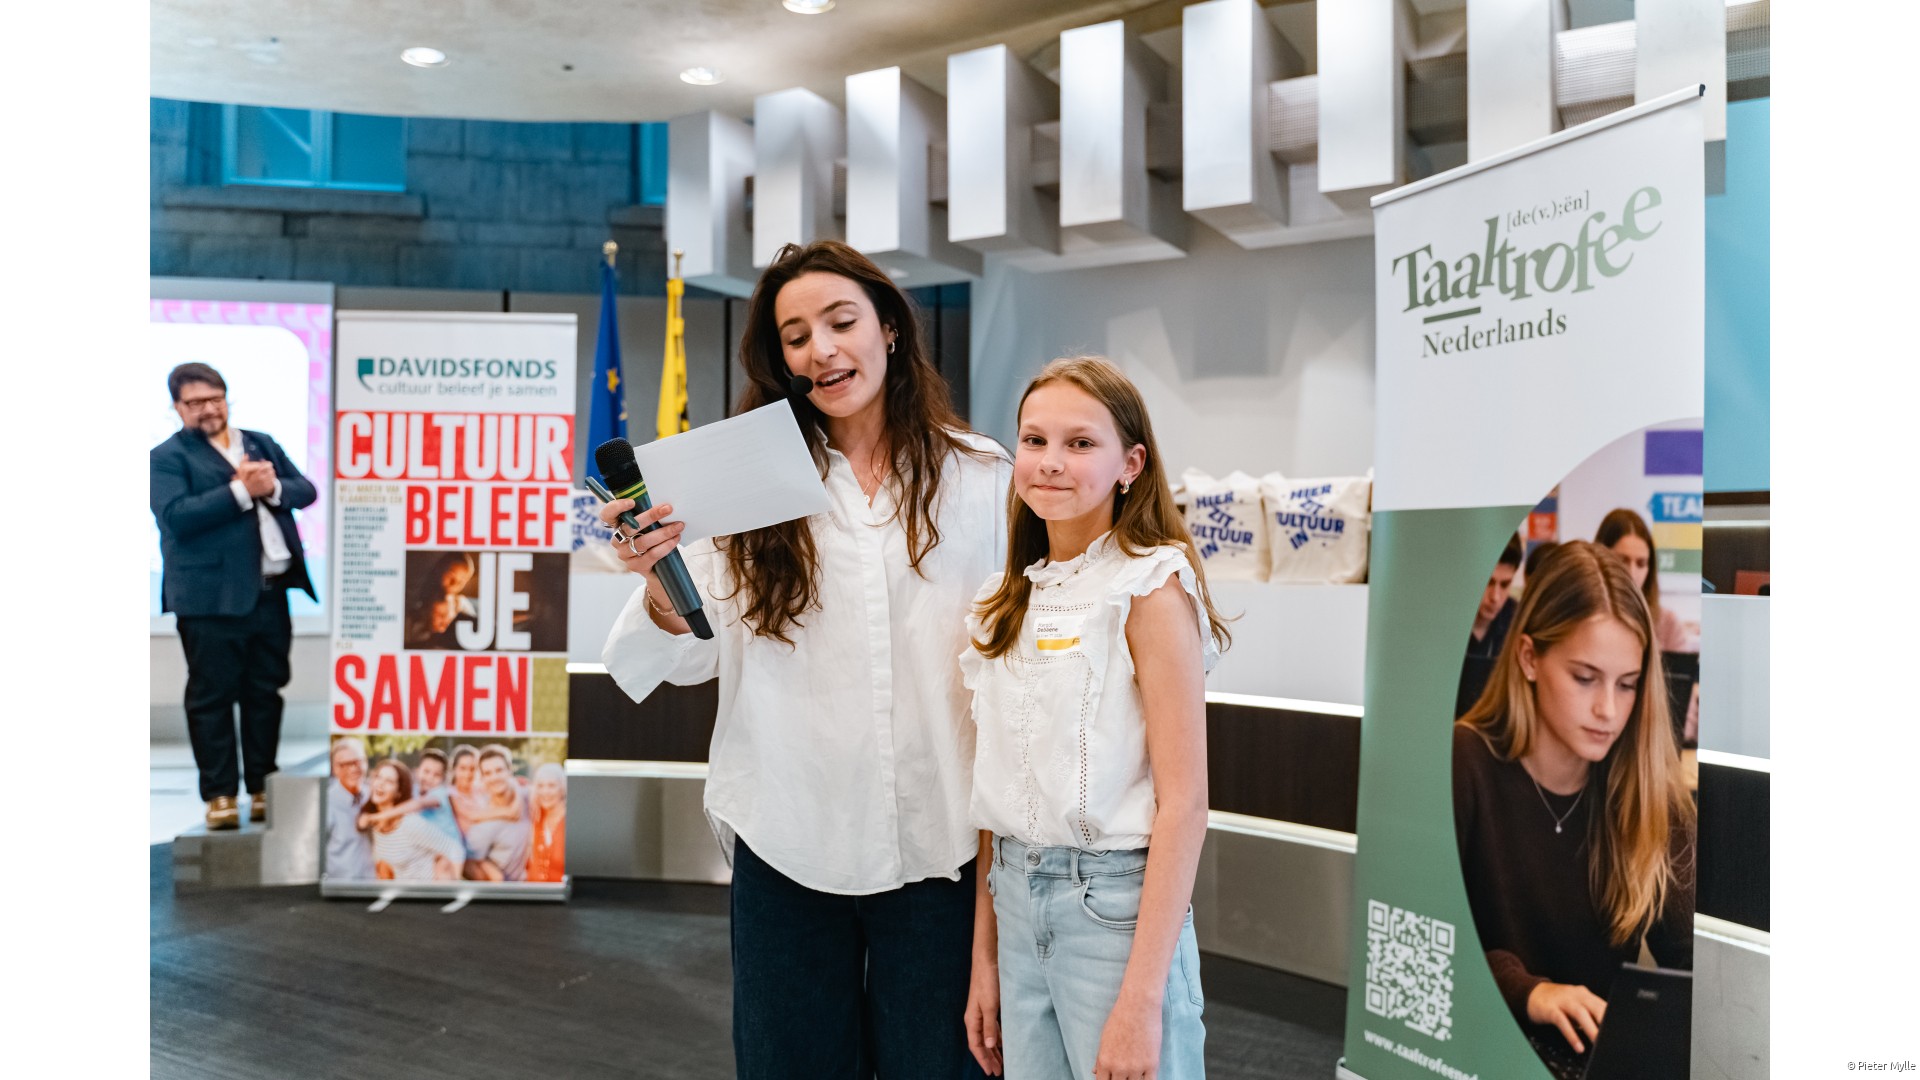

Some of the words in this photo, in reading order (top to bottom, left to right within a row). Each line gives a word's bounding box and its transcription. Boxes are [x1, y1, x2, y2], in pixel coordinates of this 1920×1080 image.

[1392, 186, 1663, 313] Taaltrofee
[1421, 308, 1568, 358] Nederlands
[379, 358, 558, 379] DAVIDSFONDS
[378, 381, 432, 395] cultuur
[438, 381, 485, 396] beleef
[488, 383, 502, 399] je
[508, 384, 557, 397] samen
[337, 412, 571, 481] CULTUUR
[1196, 491, 1234, 509] HIER
[1290, 484, 1332, 500] HIER
[406, 485, 569, 547] BELEEF
[1208, 506, 1235, 528] ZIT
[1300, 498, 1324, 516] ZIT
[1200, 541, 1219, 559] IN
[1290, 530, 1309, 550] IN
[455, 552, 533, 650] JE
[334, 654, 528, 733] SAMEN
